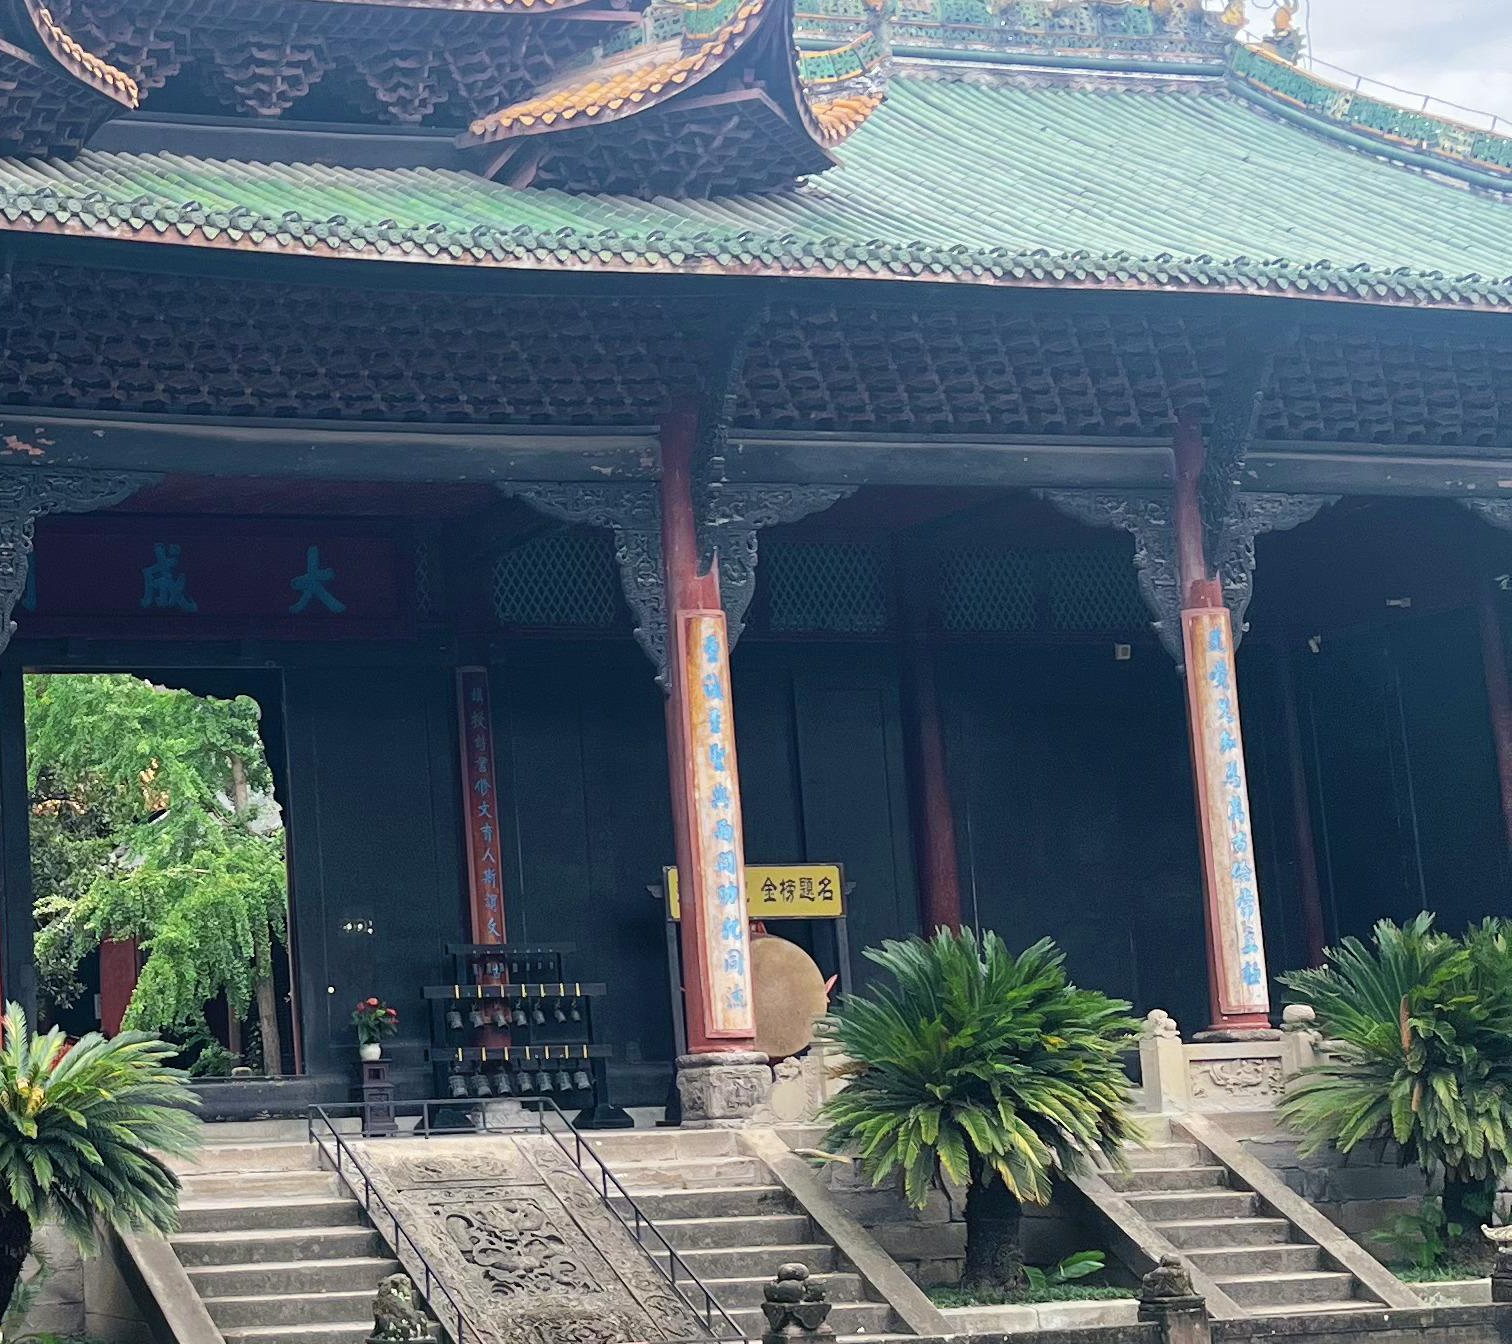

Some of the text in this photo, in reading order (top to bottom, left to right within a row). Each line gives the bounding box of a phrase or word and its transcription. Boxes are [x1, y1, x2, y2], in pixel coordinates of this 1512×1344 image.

[26, 542, 345, 613] 大成
[761, 876, 833, 904] 金榜題名
